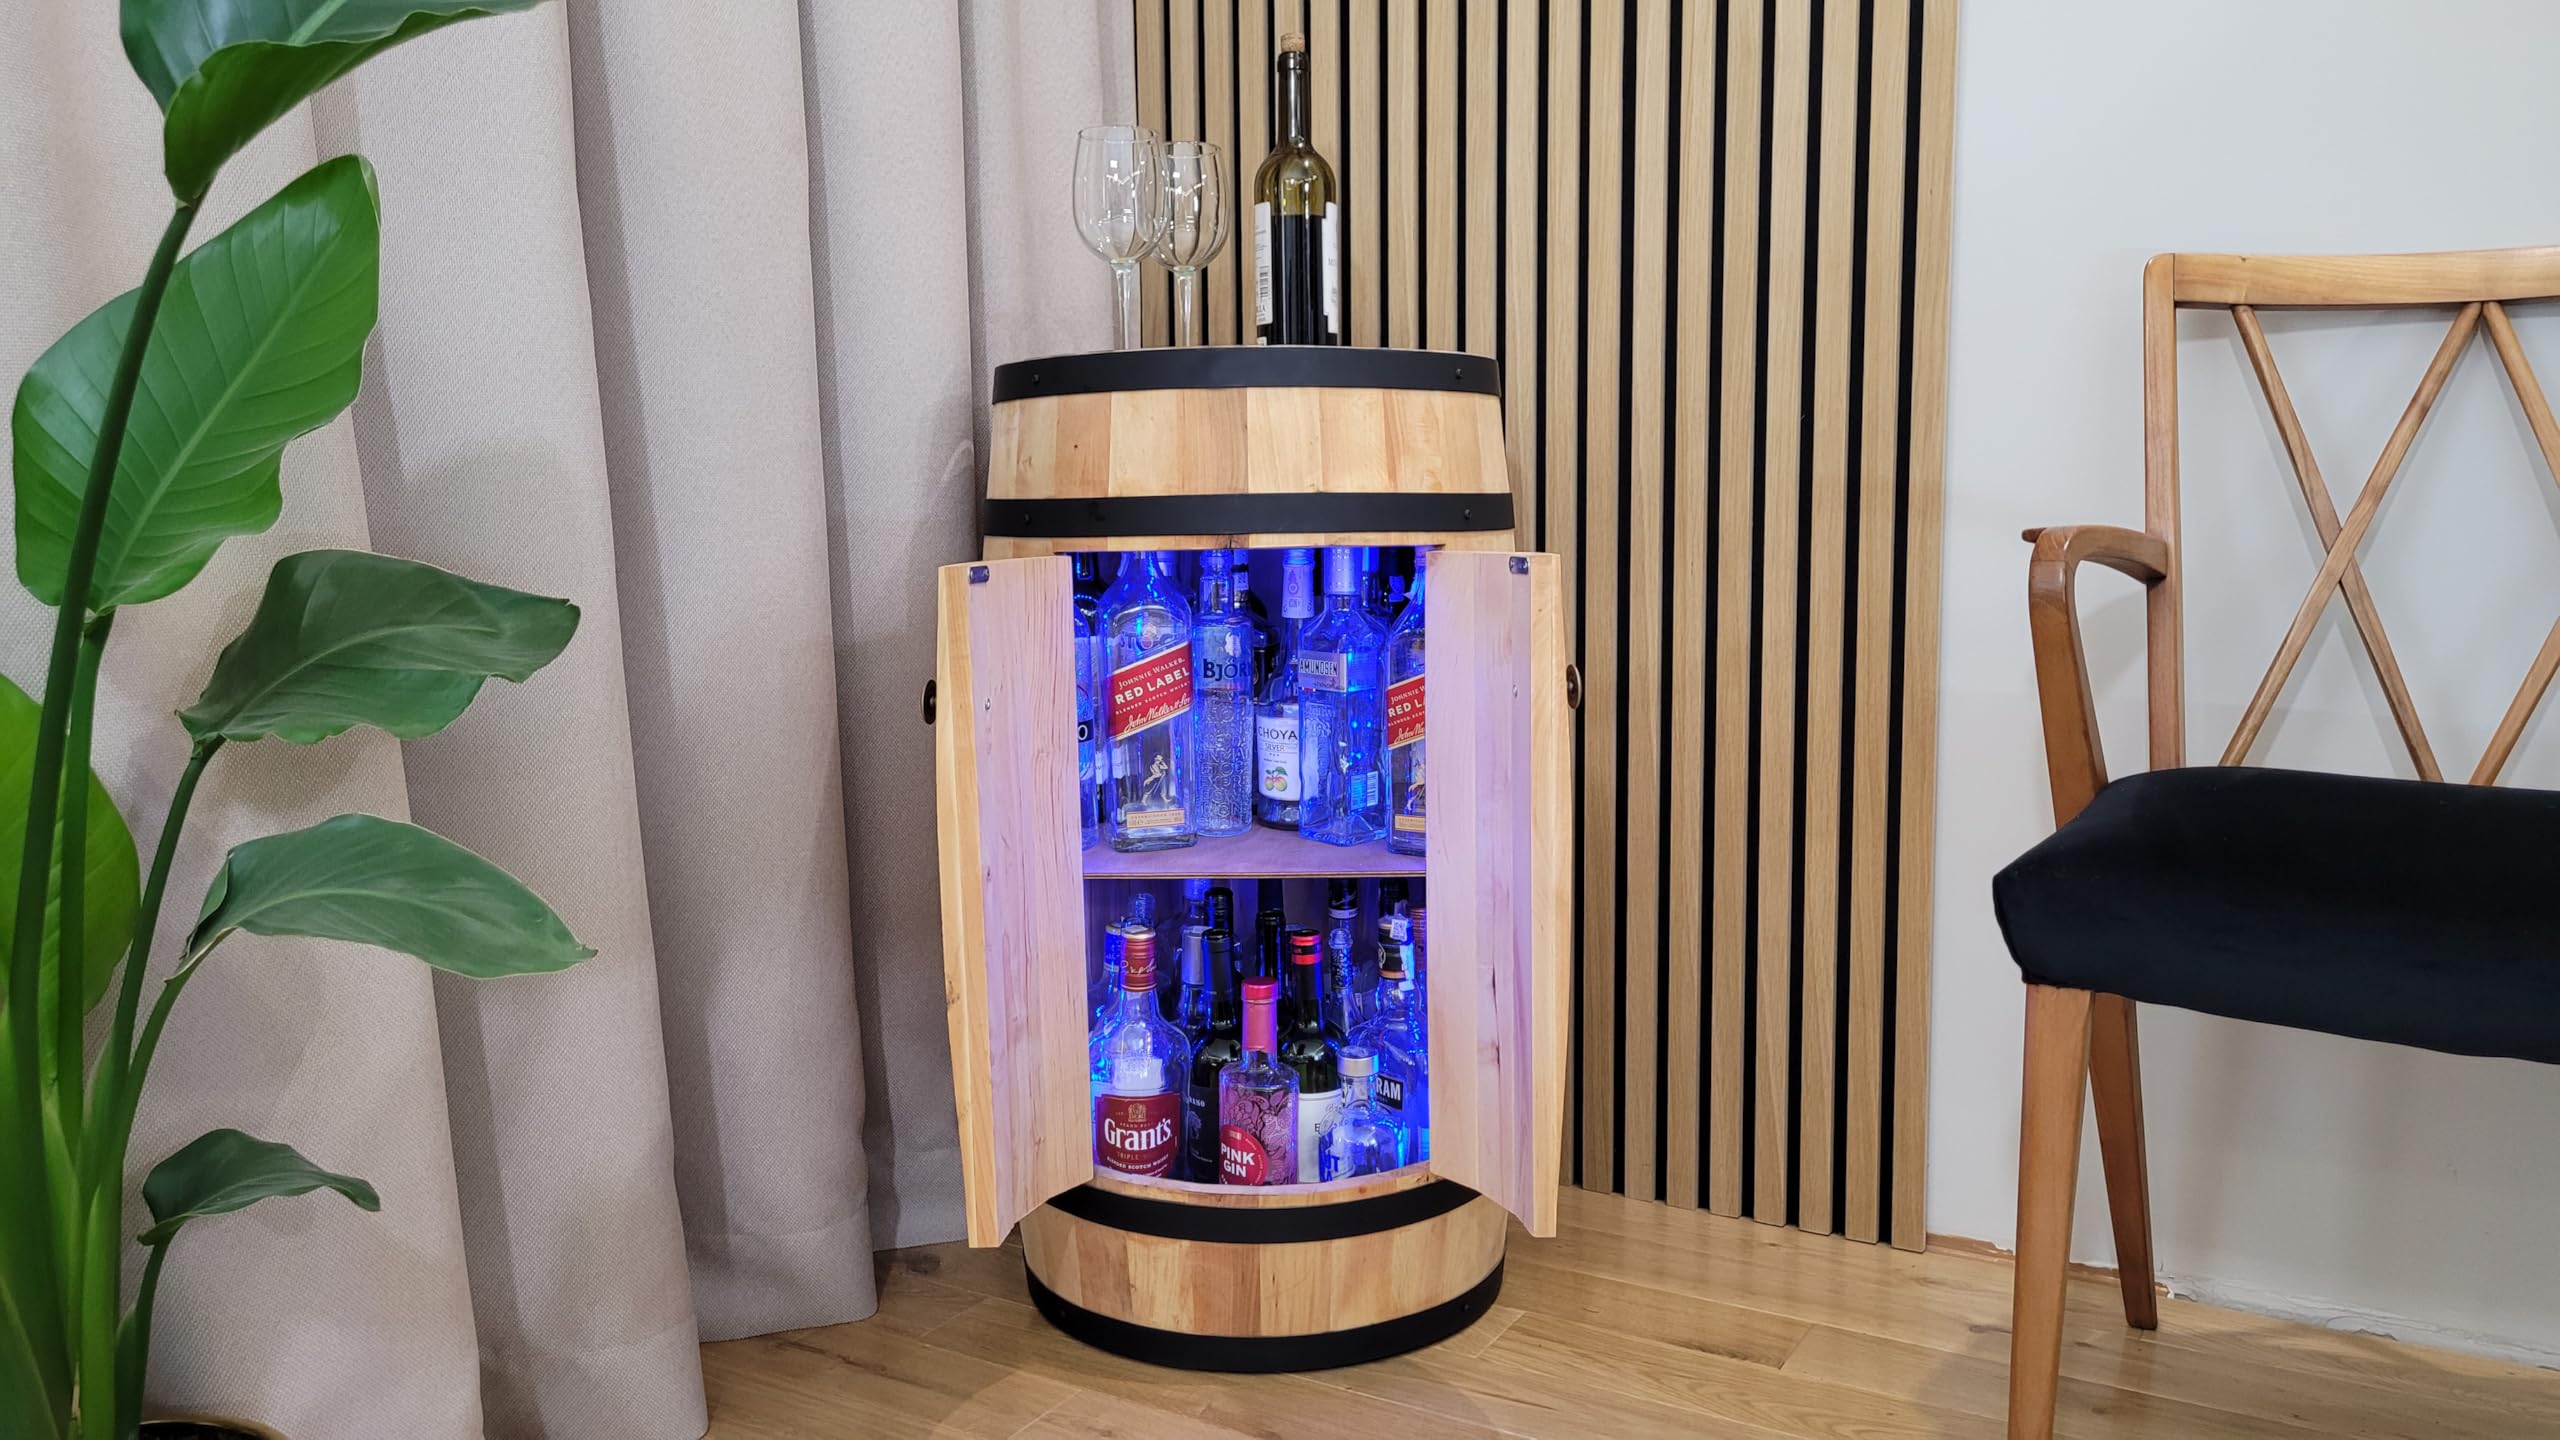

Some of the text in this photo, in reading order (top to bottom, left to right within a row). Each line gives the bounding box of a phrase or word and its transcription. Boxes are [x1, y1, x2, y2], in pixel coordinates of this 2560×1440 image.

[1115, 667, 1190, 705] RED LABEL
[1118, 670, 1152, 690] JOHNNIE
[1388, 702, 1412, 718] RED
[1258, 726, 1298, 740] CHOYA
[1264, 742, 1285, 752] SILVER
[1104, 1117, 1171, 1151] Grant's
[1221, 1142, 1255, 1166] PINK
[1223, 1160, 1247, 1178] GIN
